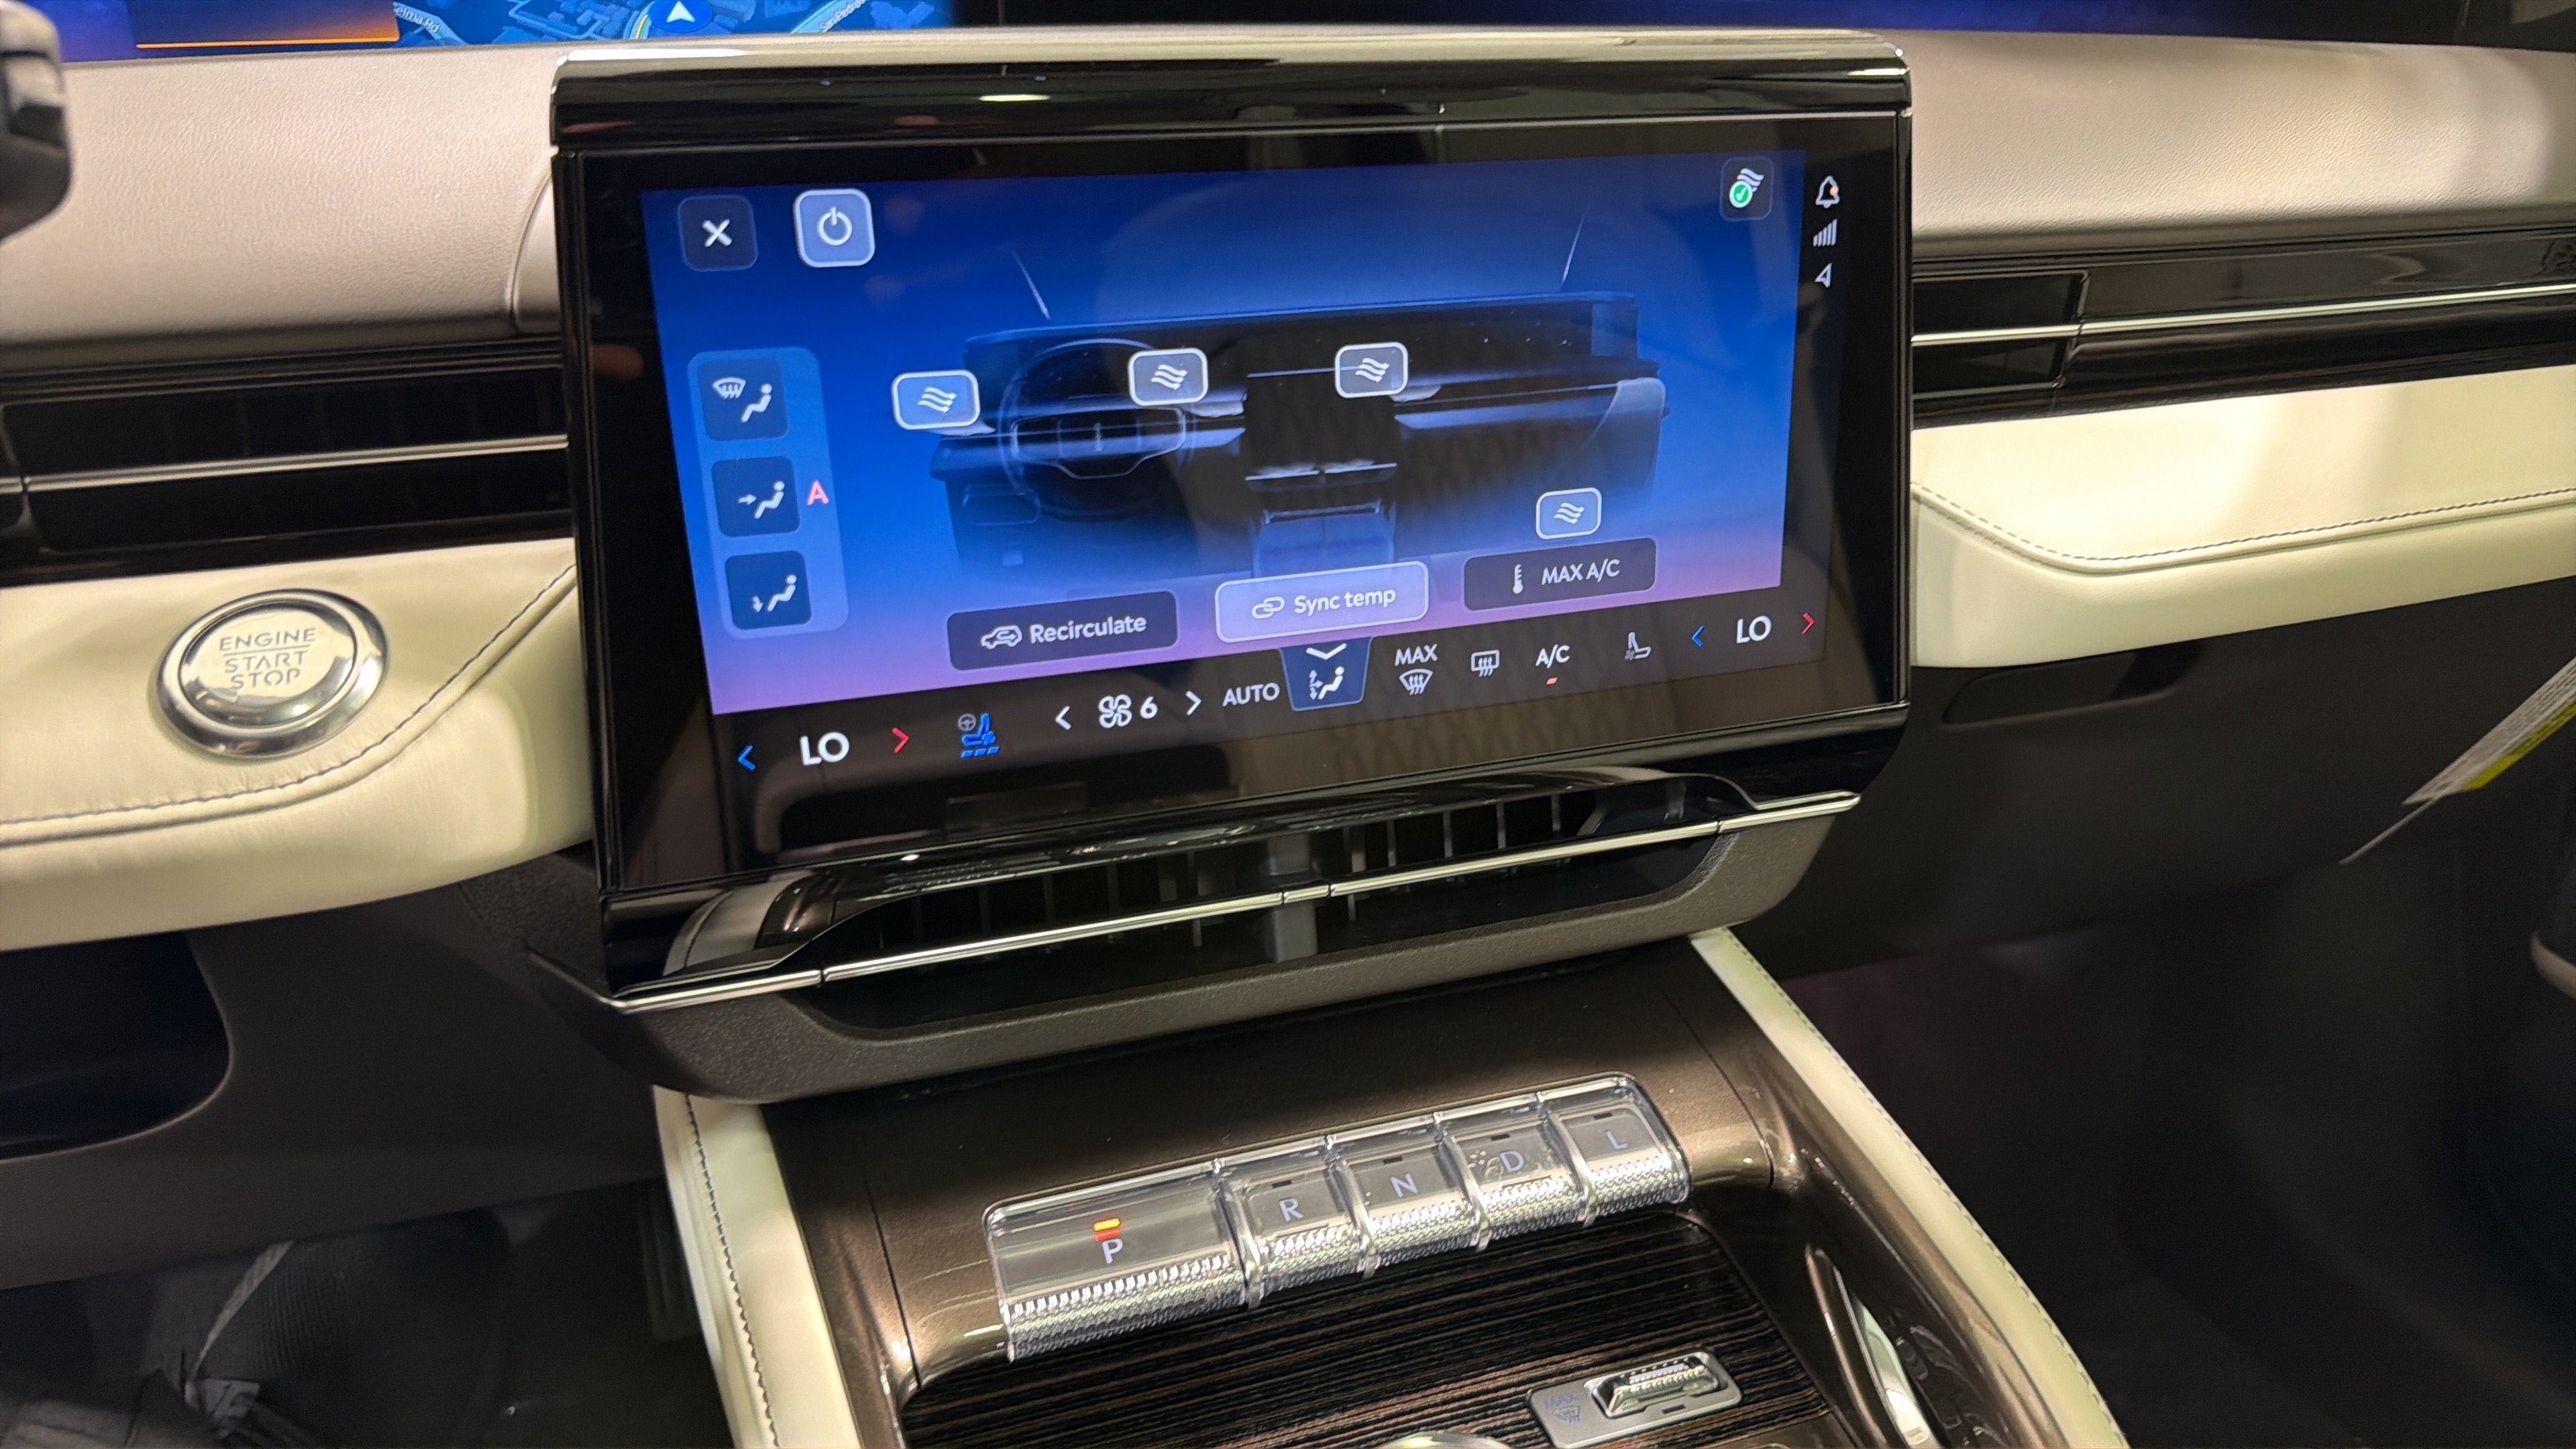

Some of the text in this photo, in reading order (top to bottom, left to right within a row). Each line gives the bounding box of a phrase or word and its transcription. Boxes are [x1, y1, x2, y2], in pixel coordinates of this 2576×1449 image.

[393, 5, 440, 32] elma Rd
[807, 480, 830, 506] A
[1541, 558, 1621, 586] MAX A/C
[1293, 586, 1397, 617] Sync temp
[219, 628, 316, 651] ENGINE
[1030, 616, 1146, 644] Recirculate
[1735, 614, 1772, 644] LO
[225, 651, 309, 674] START
[1394, 643, 1439, 666] MAX
[1535, 643, 1570, 668] A/C
[231, 667, 301, 690] STOP
[1222, 682, 1281, 708] AUTO
[1139, 696, 1159, 720] 6
[800, 731, 850, 766] LO
[1605, 1130, 1628, 1150] L
[1500, 1150, 1524, 1172] D
[1390, 1173, 1417, 1198] N
[1279, 1197, 1303, 1222] R
[1102, 1238, 1124, 1264] P
